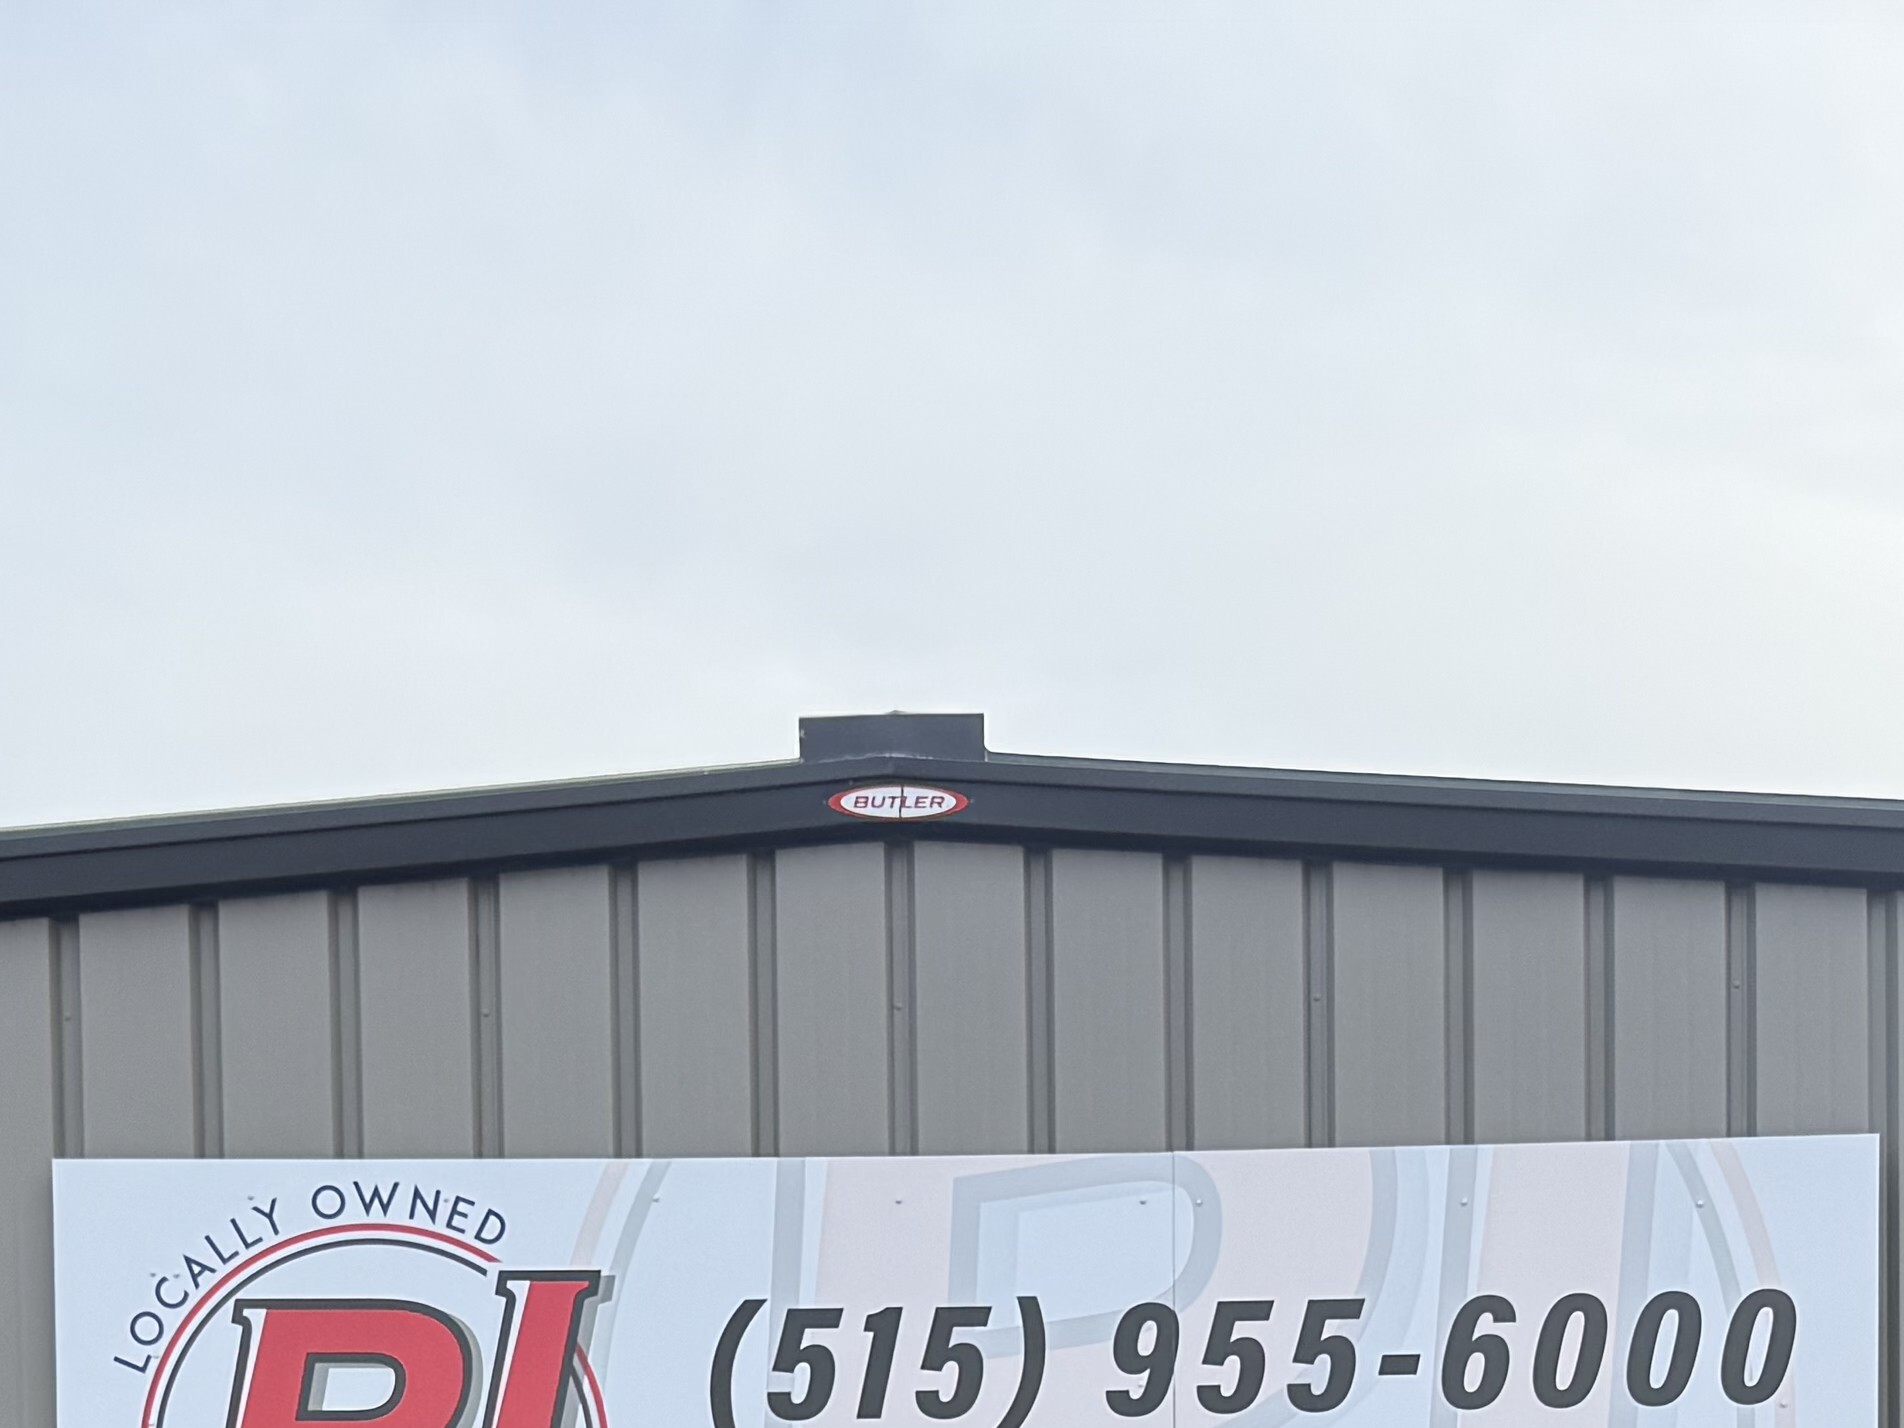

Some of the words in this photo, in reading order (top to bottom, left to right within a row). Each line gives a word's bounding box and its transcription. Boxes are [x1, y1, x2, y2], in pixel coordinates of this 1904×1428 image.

[853, 795, 945, 809] BUTLER
[113, 1197, 282, 1375] LOCALLY
[310, 1181, 507, 1247] OWNED
[1104, 1288, 1798, 1418] 955-6000
